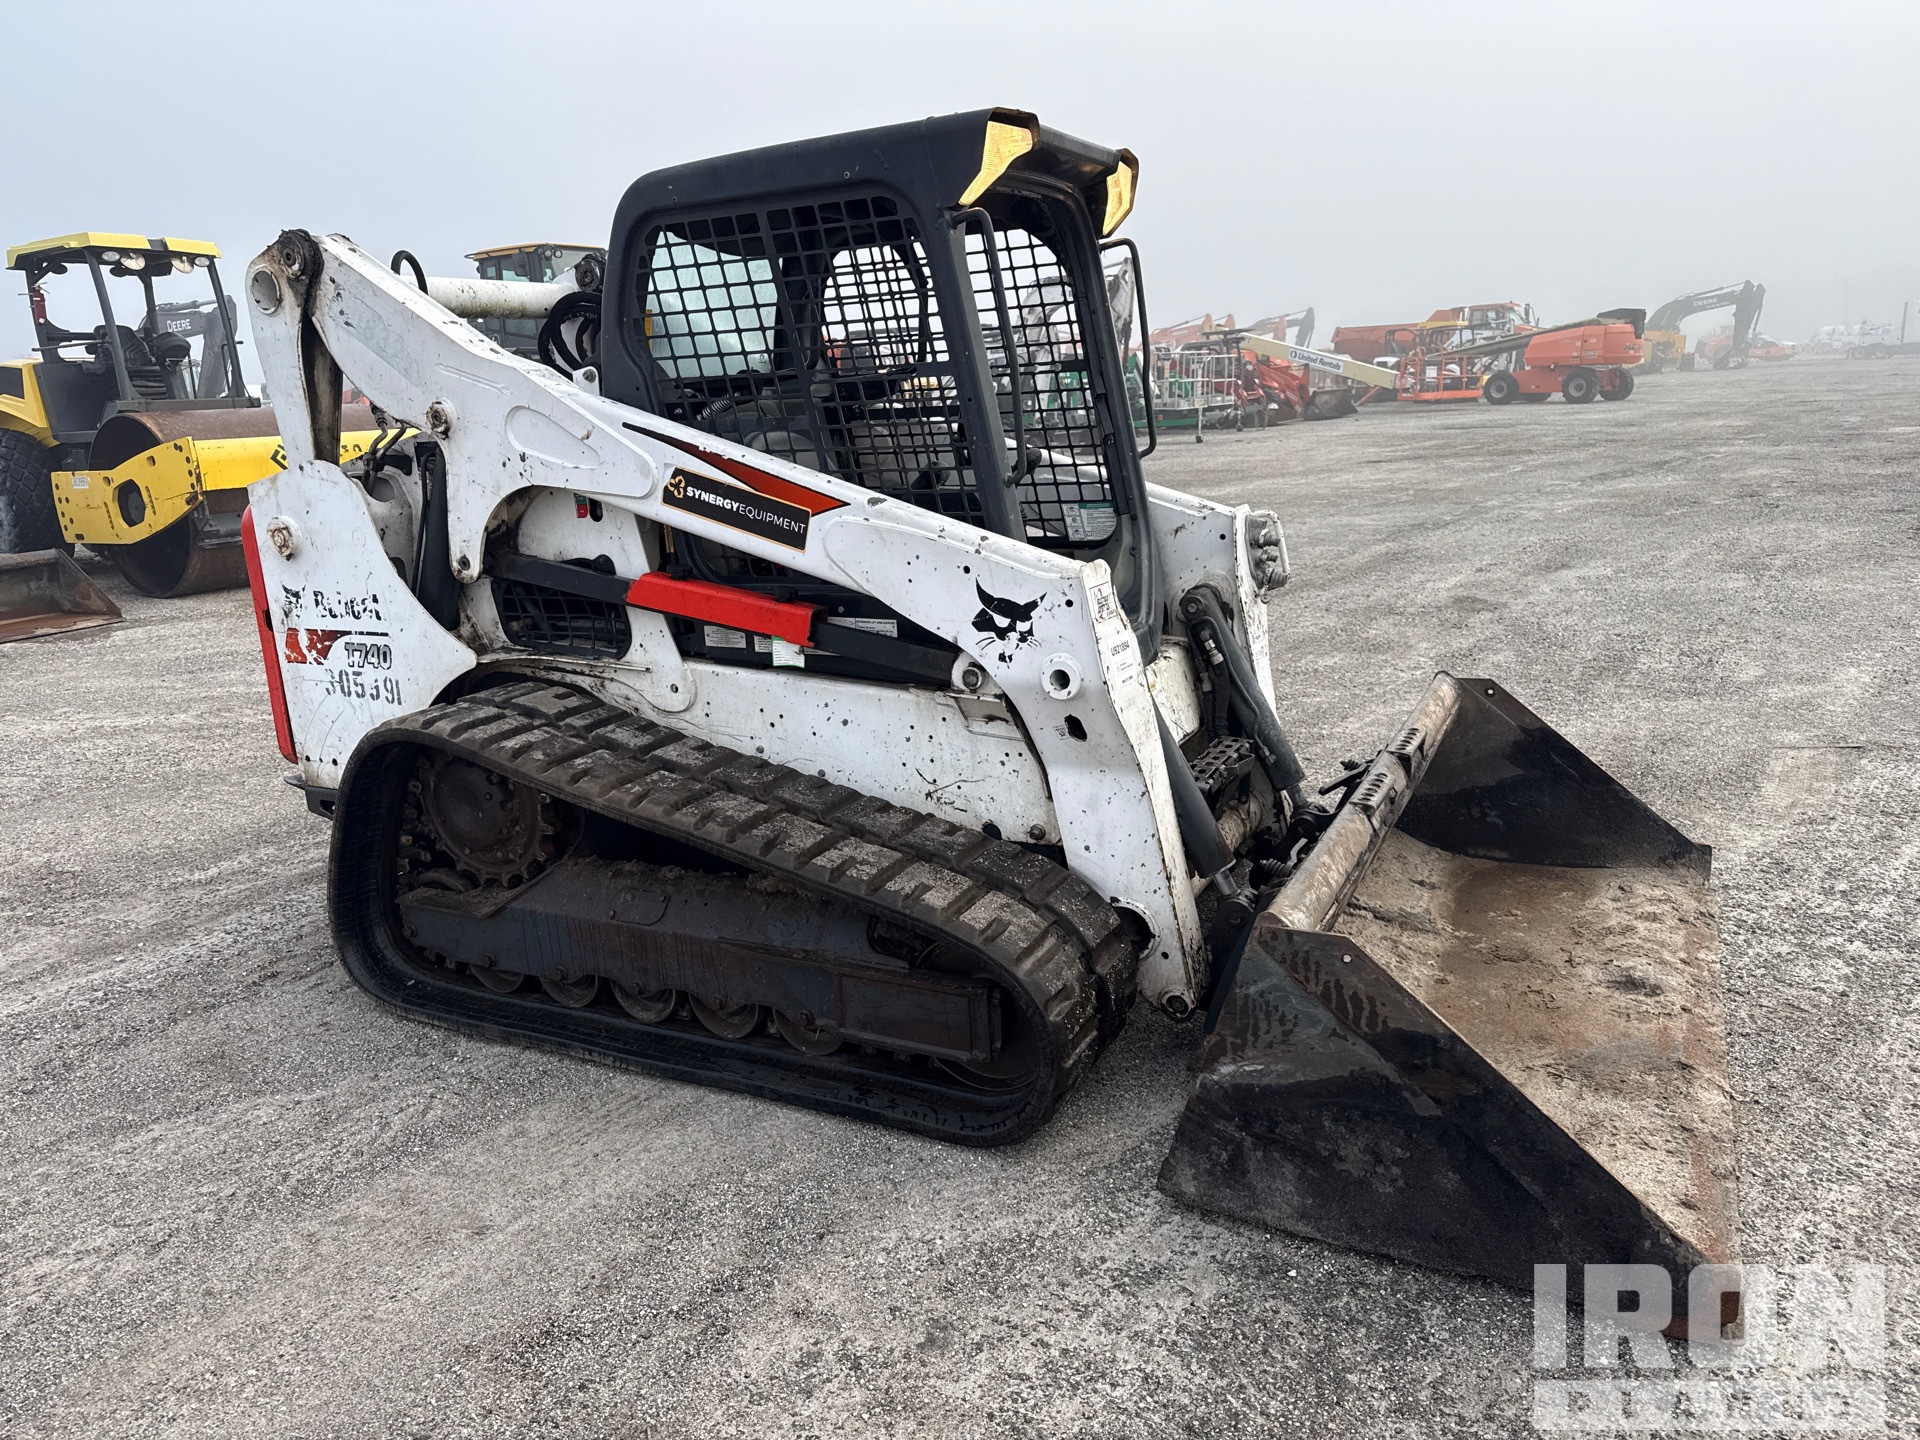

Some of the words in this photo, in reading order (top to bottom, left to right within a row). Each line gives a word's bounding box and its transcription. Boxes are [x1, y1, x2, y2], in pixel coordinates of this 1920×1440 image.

[1693, 297, 1718, 307] DEERE
[166, 318, 192, 333] DEERE
[1297, 351, 1318, 364] United
[1318, 357, 1341, 371] Rentals
[344, 641, 393, 670] T740
